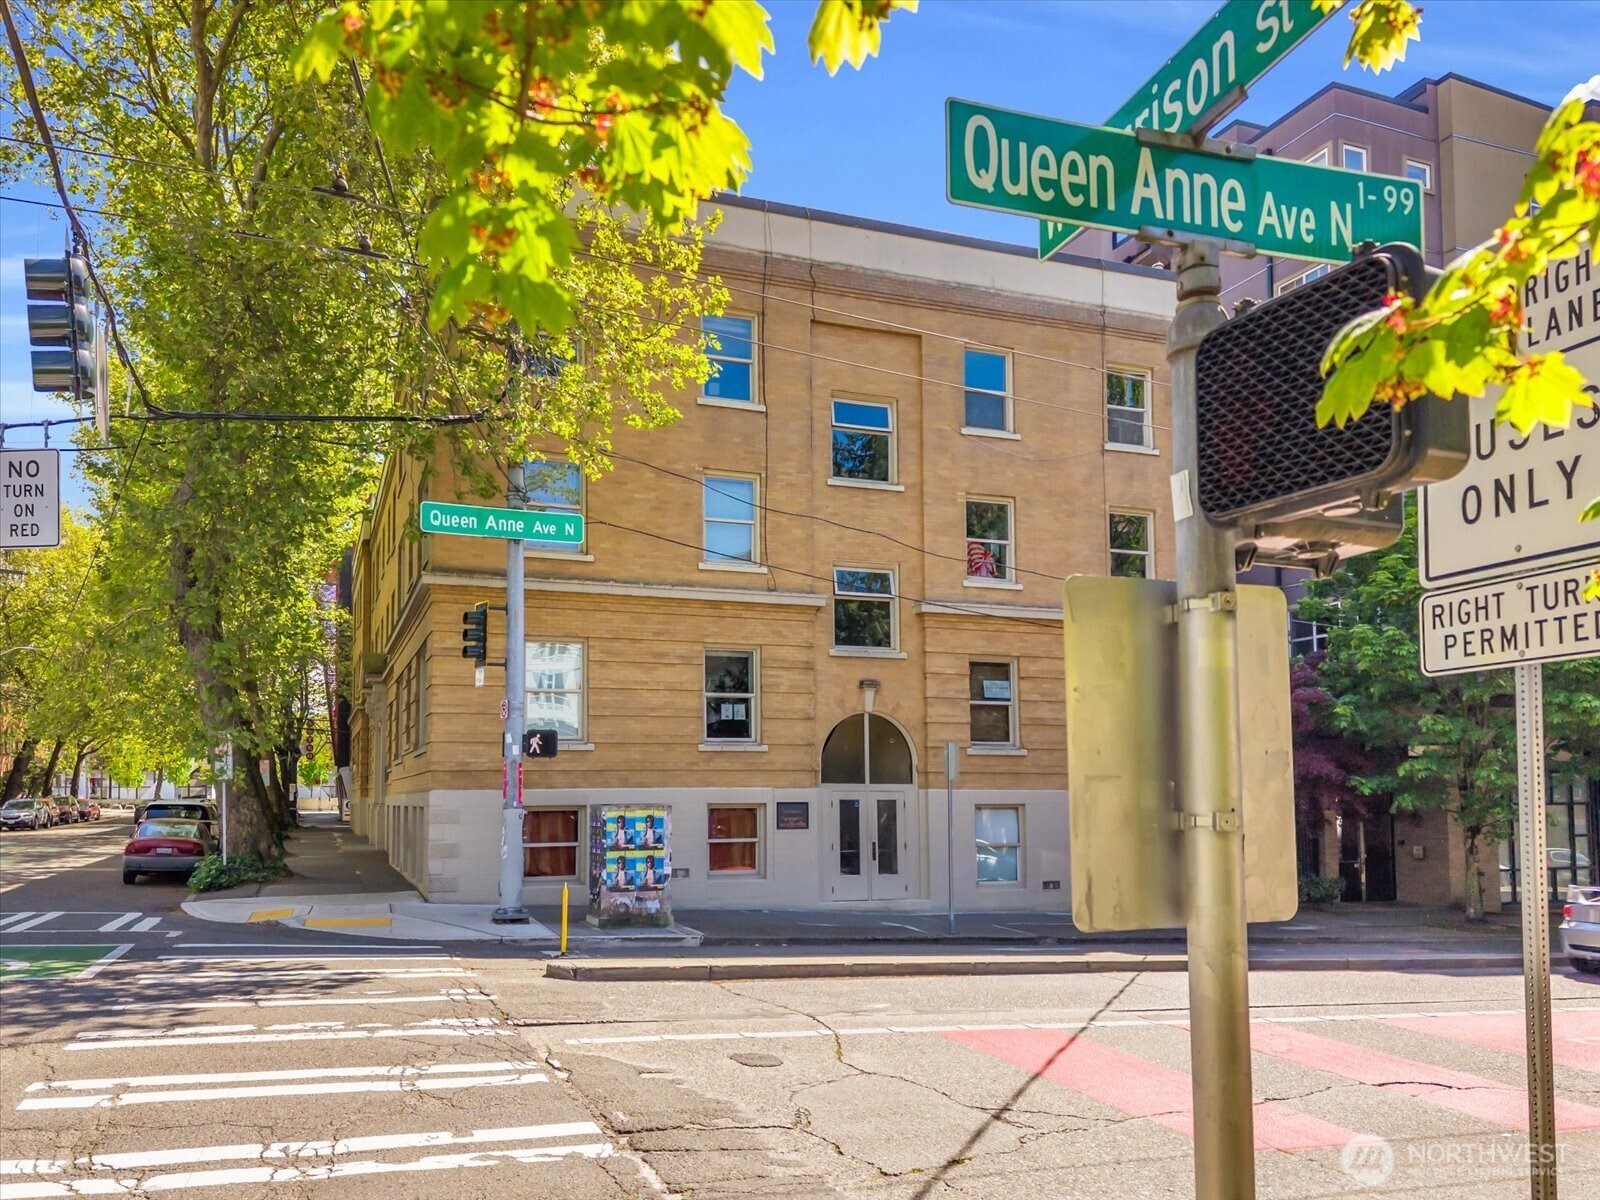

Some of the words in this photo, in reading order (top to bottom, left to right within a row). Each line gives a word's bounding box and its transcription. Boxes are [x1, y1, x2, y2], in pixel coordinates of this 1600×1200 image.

[1123, 30, 1236, 134] rison
[1256, 0, 1294, 53] St
[964, 114, 1116, 211] Queen
[1130, 147, 1246, 233] Anne
[1257, 191, 1316, 244] Ave
[1330, 200, 1353, 252] N
[1357, 181, 1414, 216] 1-99
[1524, 249, 1591, 308] RIGH
[8, 460, 40, 478] NO
[3, 484, 44, 498] TURN
[1461, 454, 1582, 525] ONLY
[13, 504, 34, 517] ON
[429, 509, 477, 529] Queen
[485, 515, 525, 532] Anne
[532, 521, 557, 535] Ave
[564, 522, 575, 536] N
[10, 523, 40, 537] RED
[1432, 591, 1505, 630] RIGHT
